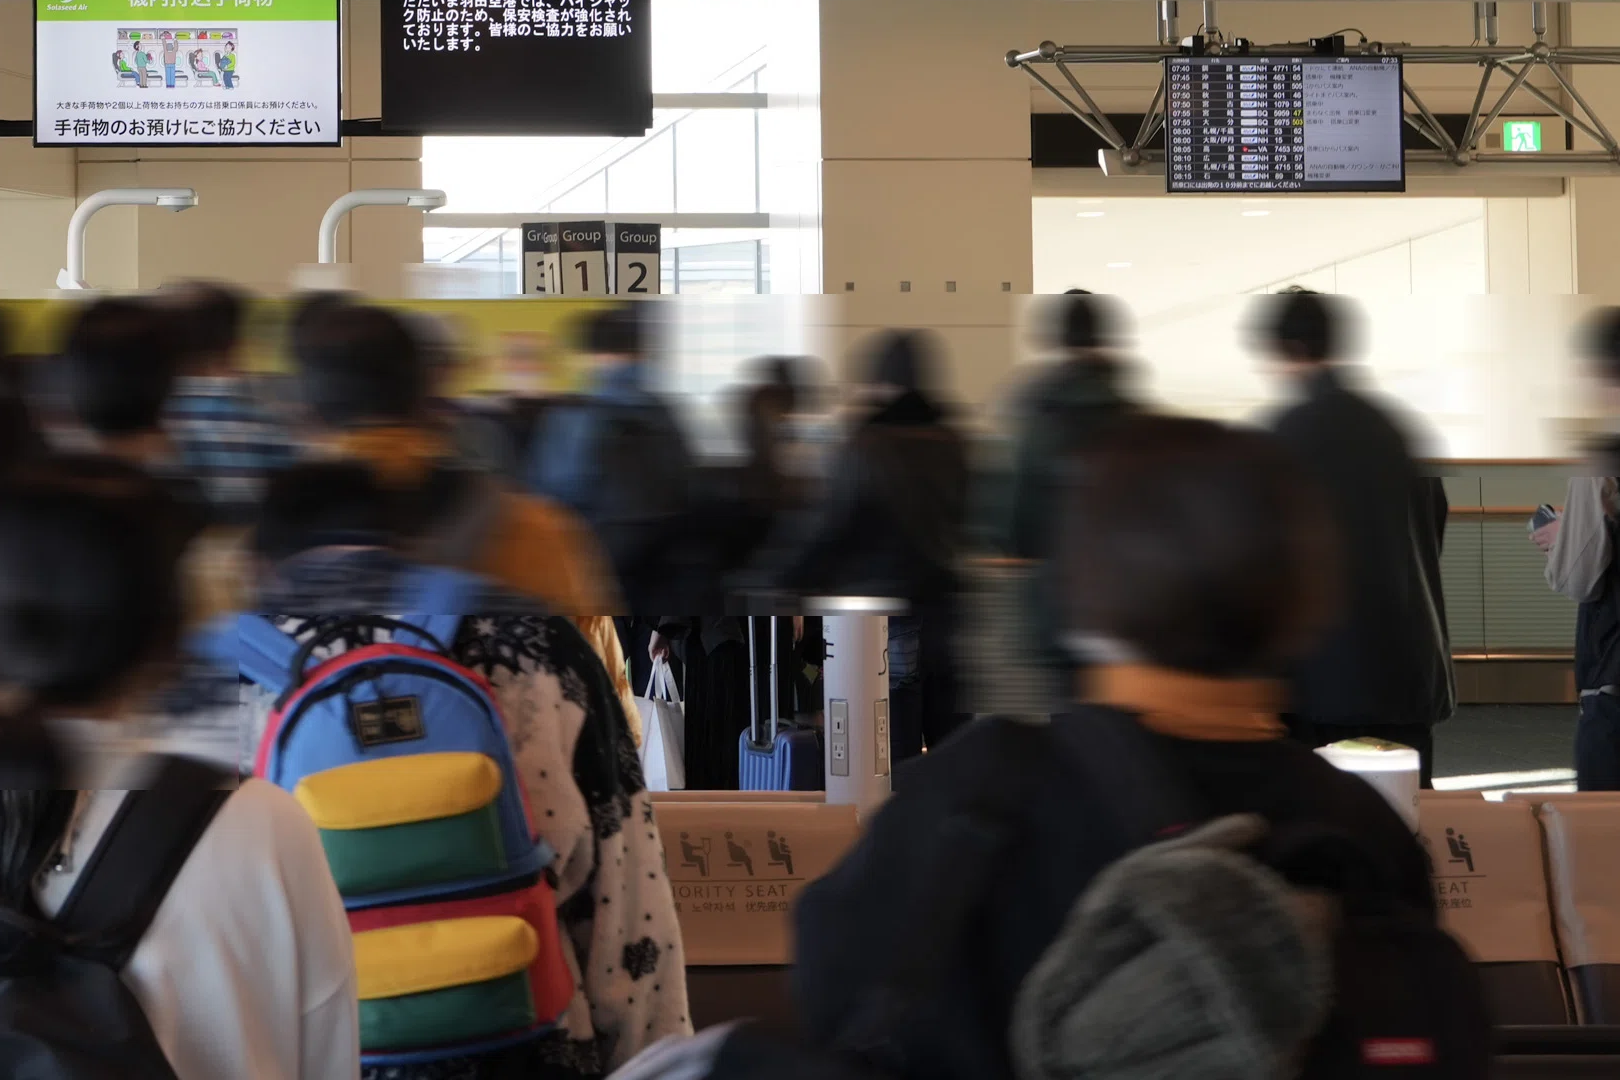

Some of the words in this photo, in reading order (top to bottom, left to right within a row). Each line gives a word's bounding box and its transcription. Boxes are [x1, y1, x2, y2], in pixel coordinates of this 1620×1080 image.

[47, 3, 77, 11] Solaseed
[78, 3, 88, 11] Air
[403, 8, 632, 22] ク防止のため、保安検査が強化され
[403, 23, 632, 37] ております。皆様のご協力をお願い
[403, 37, 481, 51] いたします。
[54, 118, 321, 137] 手荷物のお預けにご協力ください
[562, 230, 602, 243] Group
[620, 231, 657, 245] Group
[575, 260, 589, 292] 1
[627, 261, 648, 293] 2
[672, 885, 735, 898] IORITY
[746, 885, 788, 898] SEAT
[1438, 882, 1469, 894] EAT
